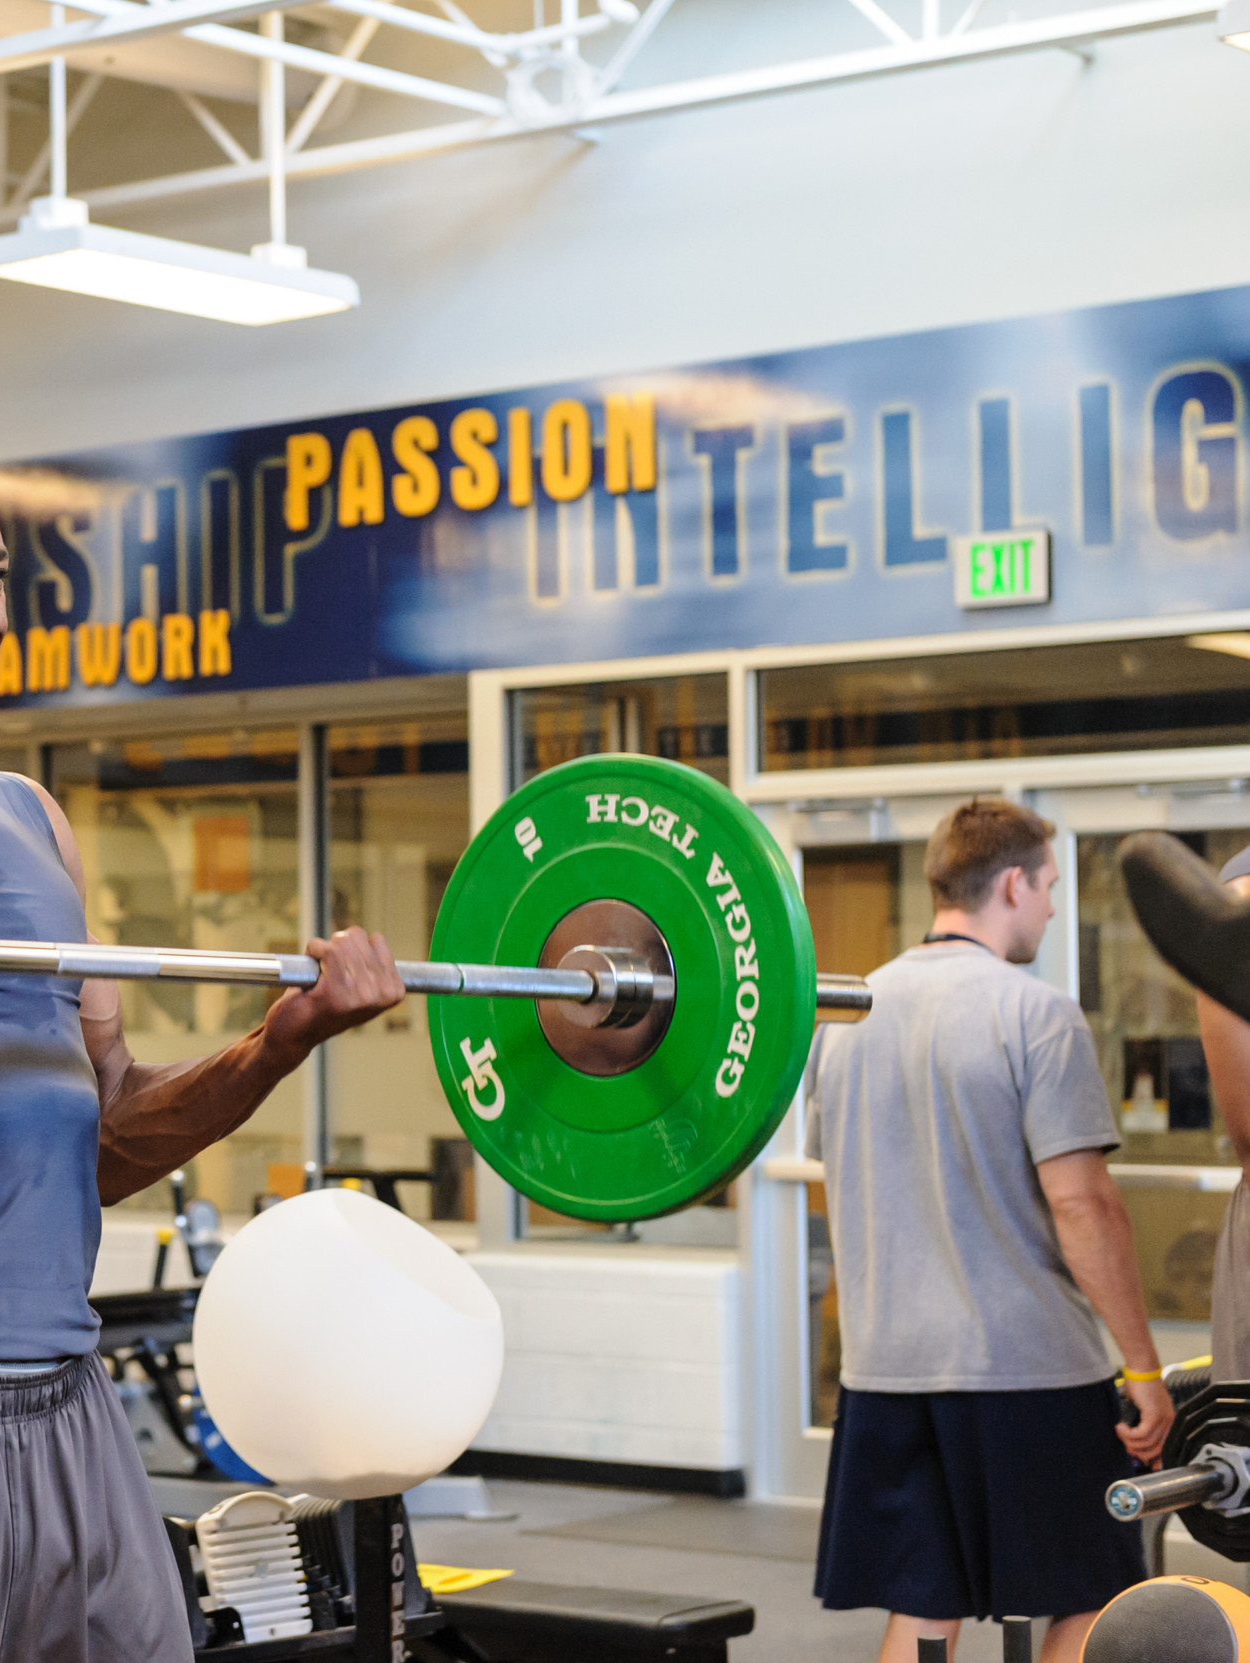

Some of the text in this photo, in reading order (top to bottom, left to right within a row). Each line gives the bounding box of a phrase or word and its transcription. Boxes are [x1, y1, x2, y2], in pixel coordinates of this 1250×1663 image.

[285, 392, 657, 530] PASSION
[970, 538, 1034, 600] EXIT
[514, 816, 544, 864] 10
[585, 793, 760, 1098] GEORGIA TECH
[459, 1037, 507, 1122] GT
